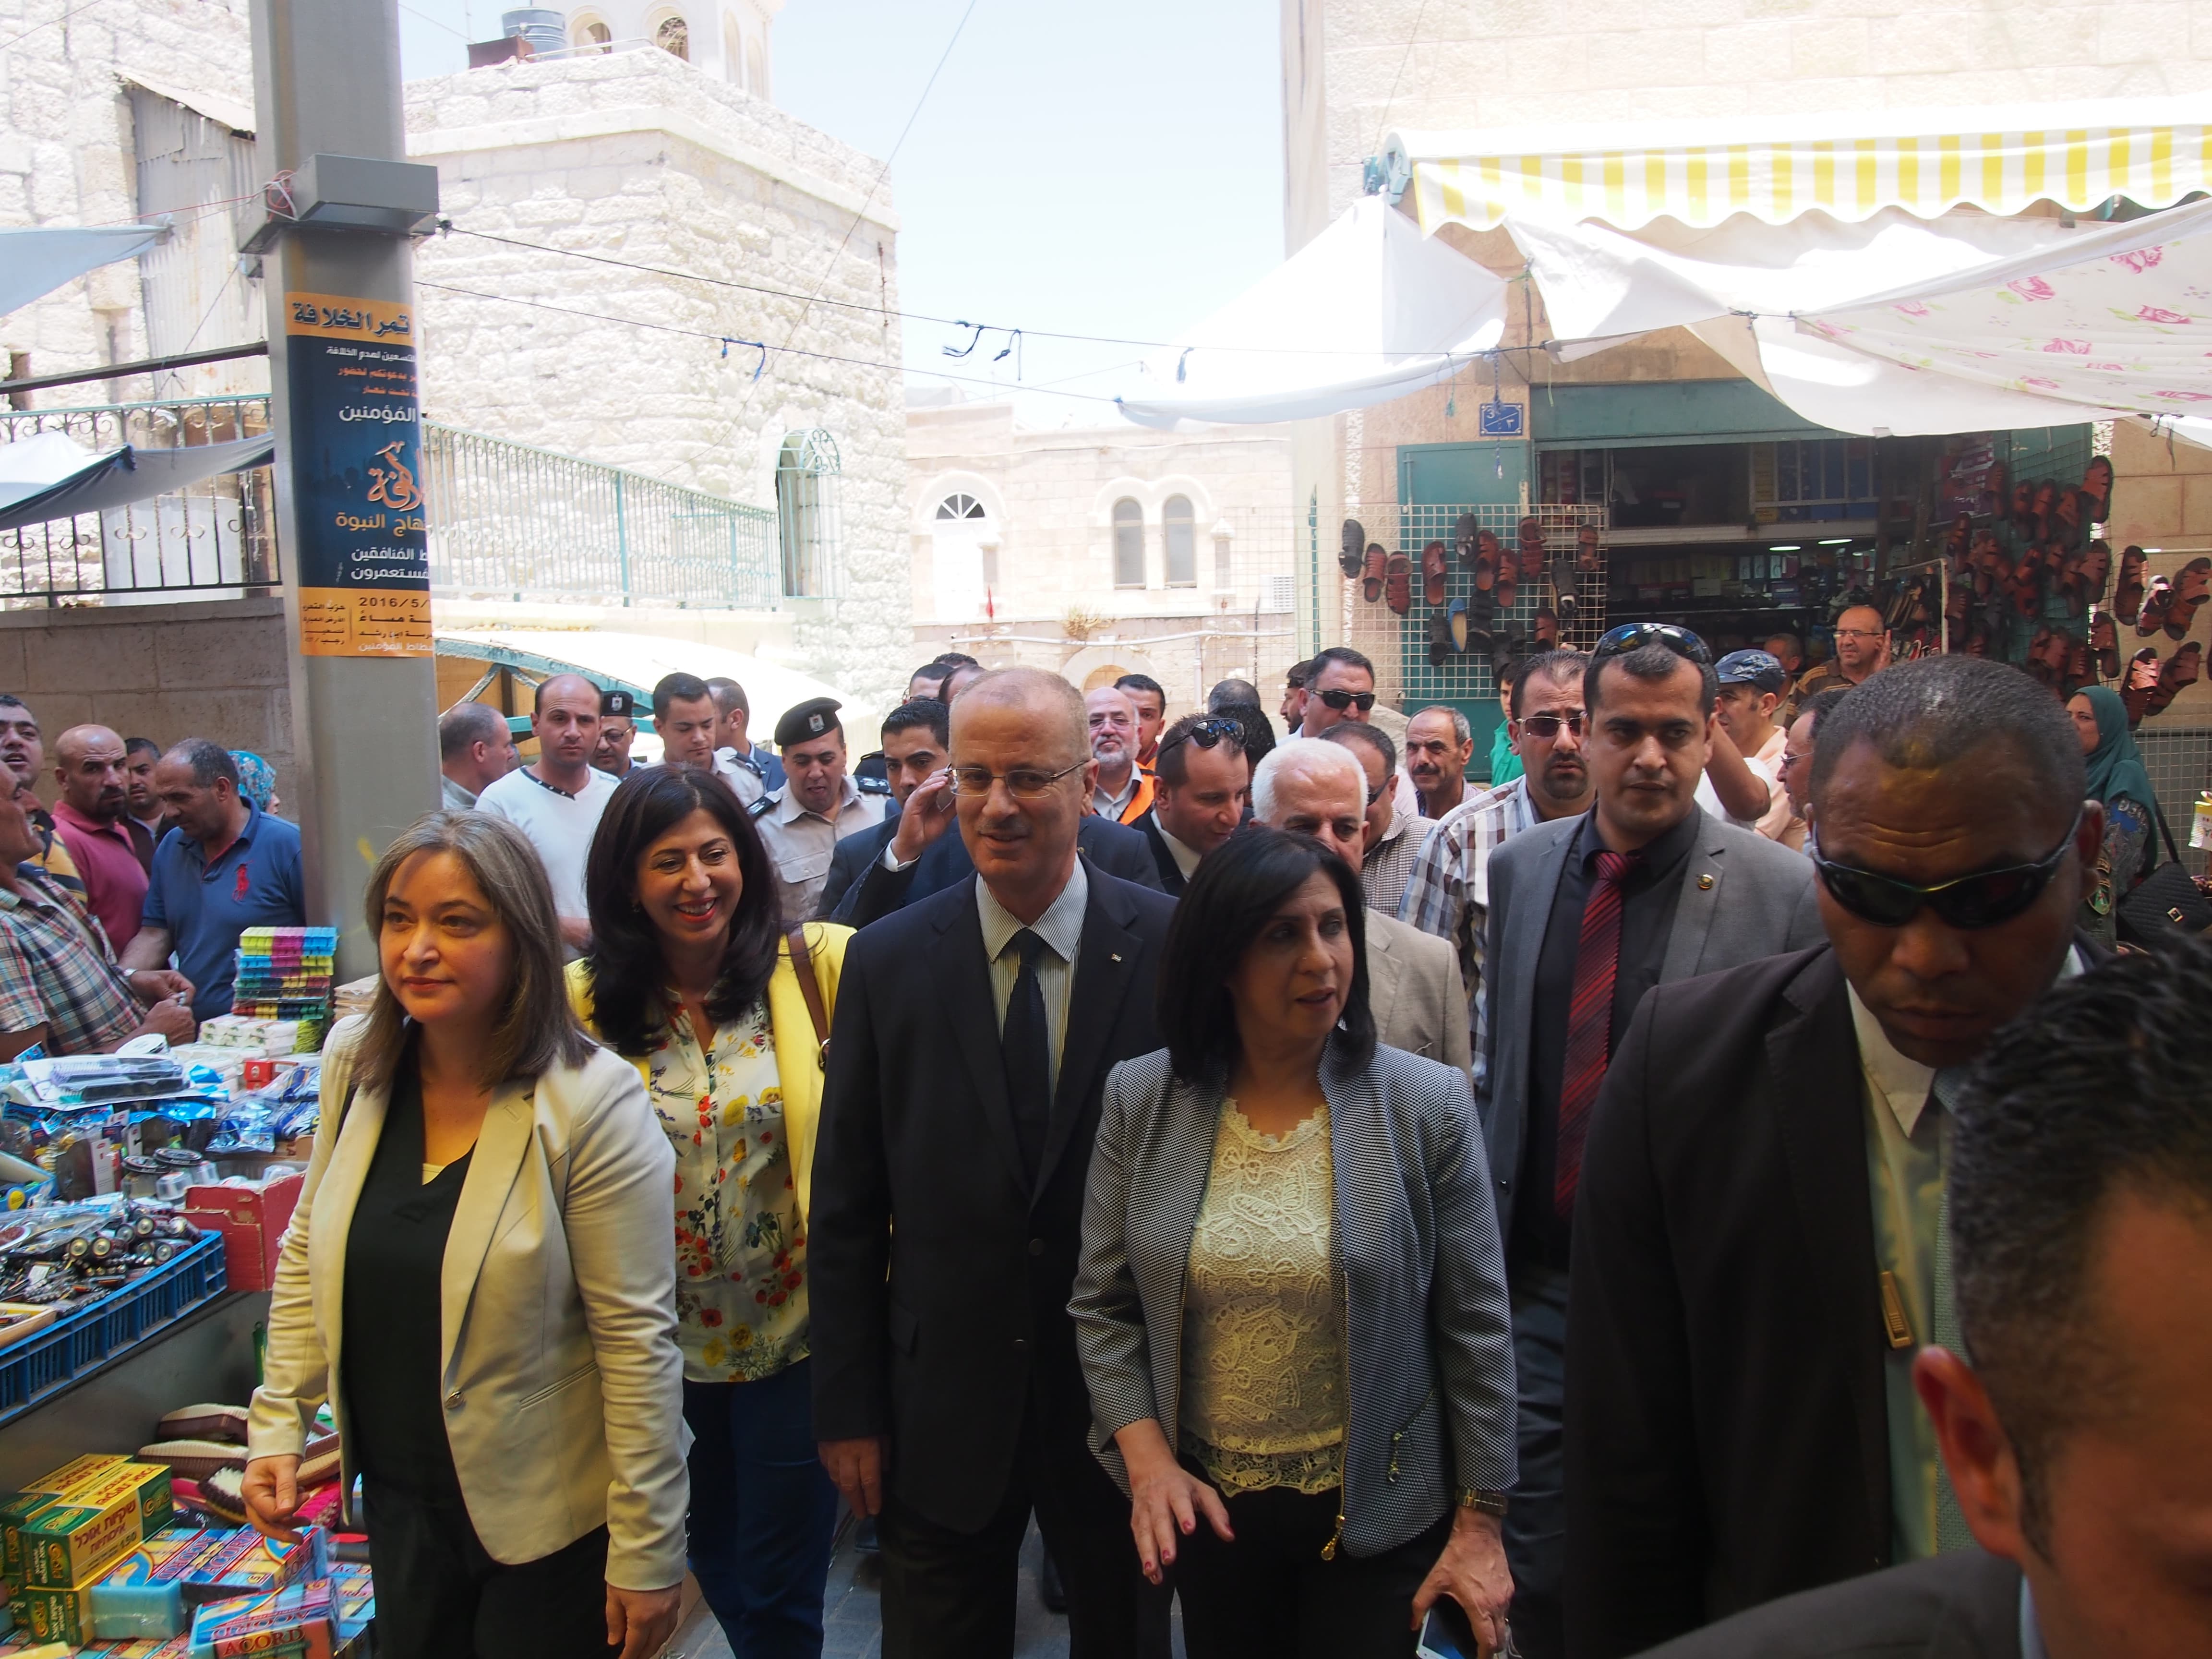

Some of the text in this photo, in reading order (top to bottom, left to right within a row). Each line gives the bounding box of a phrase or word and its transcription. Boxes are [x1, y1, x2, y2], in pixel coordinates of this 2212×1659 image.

[291, 301, 372, 330] الخلافة
[326, 346, 358, 357] الخلافة
[336, 511, 385, 531] النبوة
[359, 597, 430, 608] 2016/5/
[223, 1627, 305, 1658] ACORD
